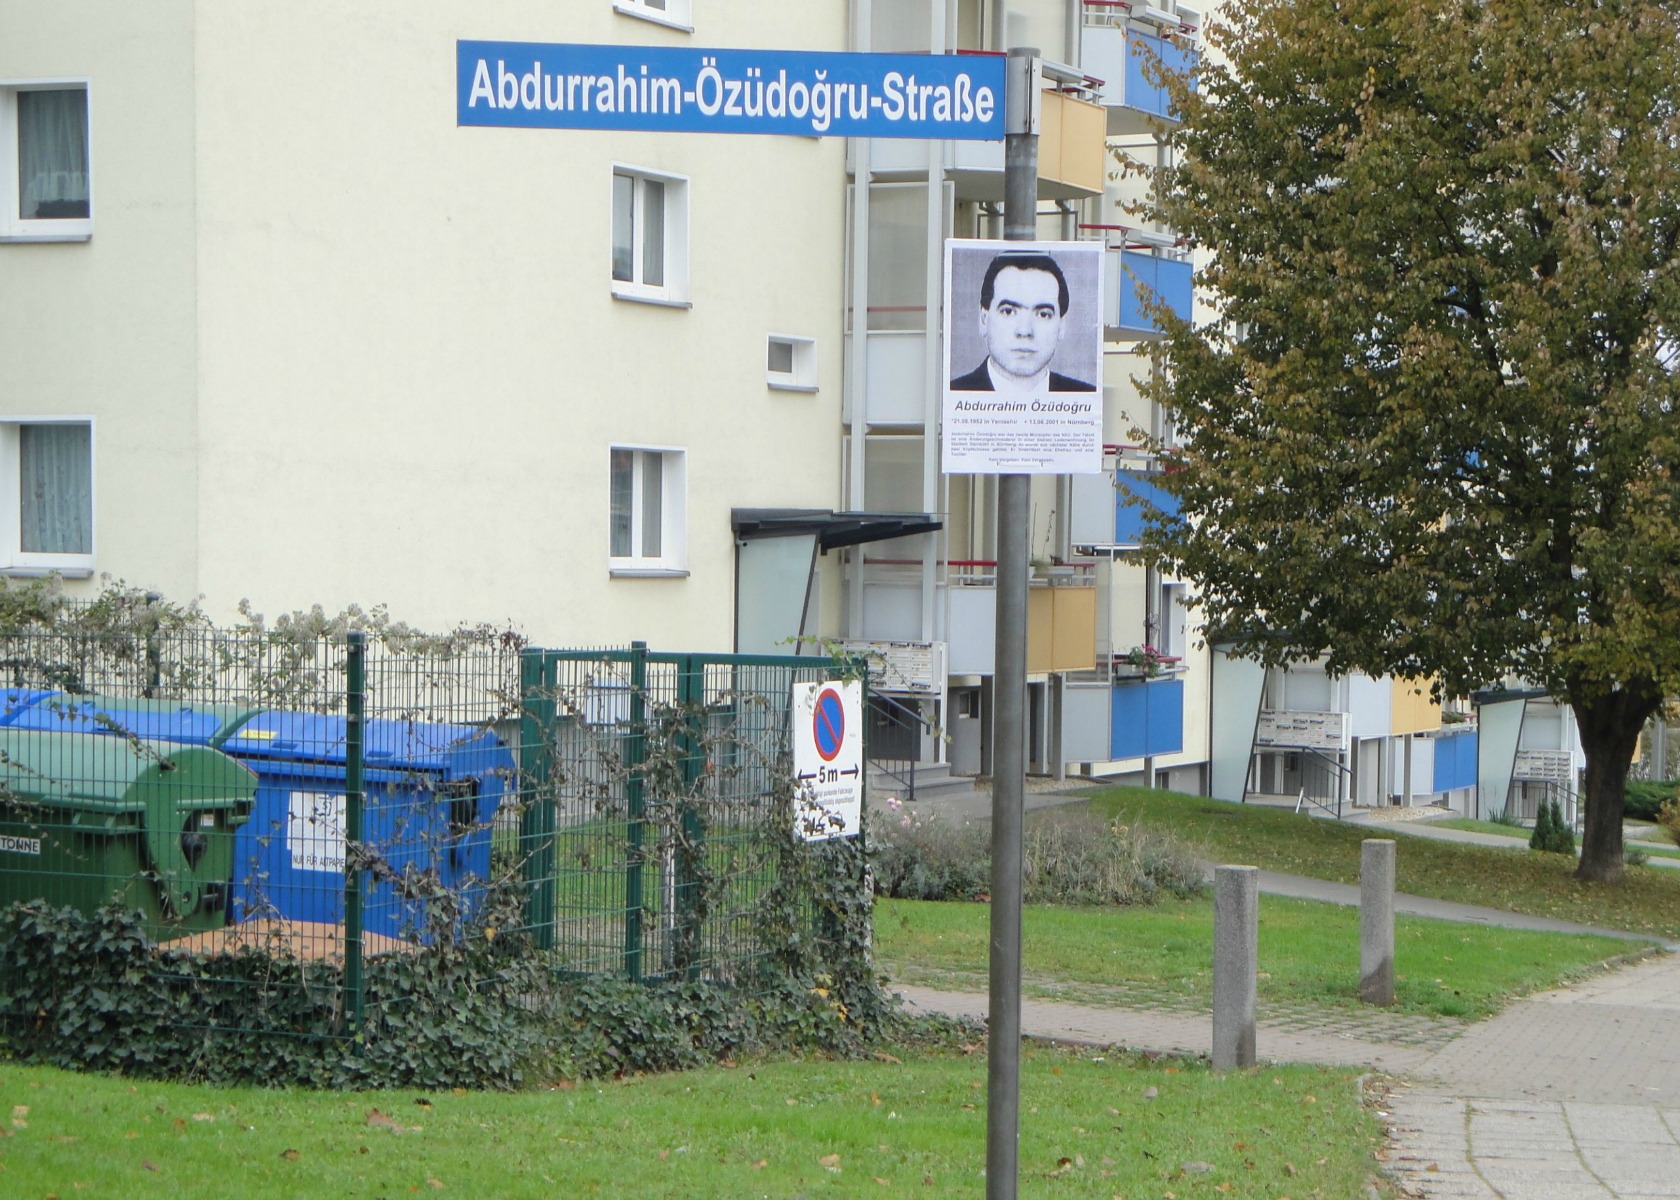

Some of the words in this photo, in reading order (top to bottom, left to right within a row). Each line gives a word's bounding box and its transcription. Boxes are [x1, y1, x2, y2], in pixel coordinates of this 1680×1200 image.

[468, 57, 995, 132] Abdurrahim-Özüdoğru-Straße
[955, 400, 1026, 412] Abdurrahim
[1031, 399, 1092, 414] Özüdoğru
[1067, 418, 1095, 426] Nürnberg
[818, 765, 826, 784] 5
[828, 767, 838, 783] m
[0, 837, 39, 853] TONNE
[306, 853, 318, 866] FÜR
[320, 856, 345, 868] ALTPAPIE
